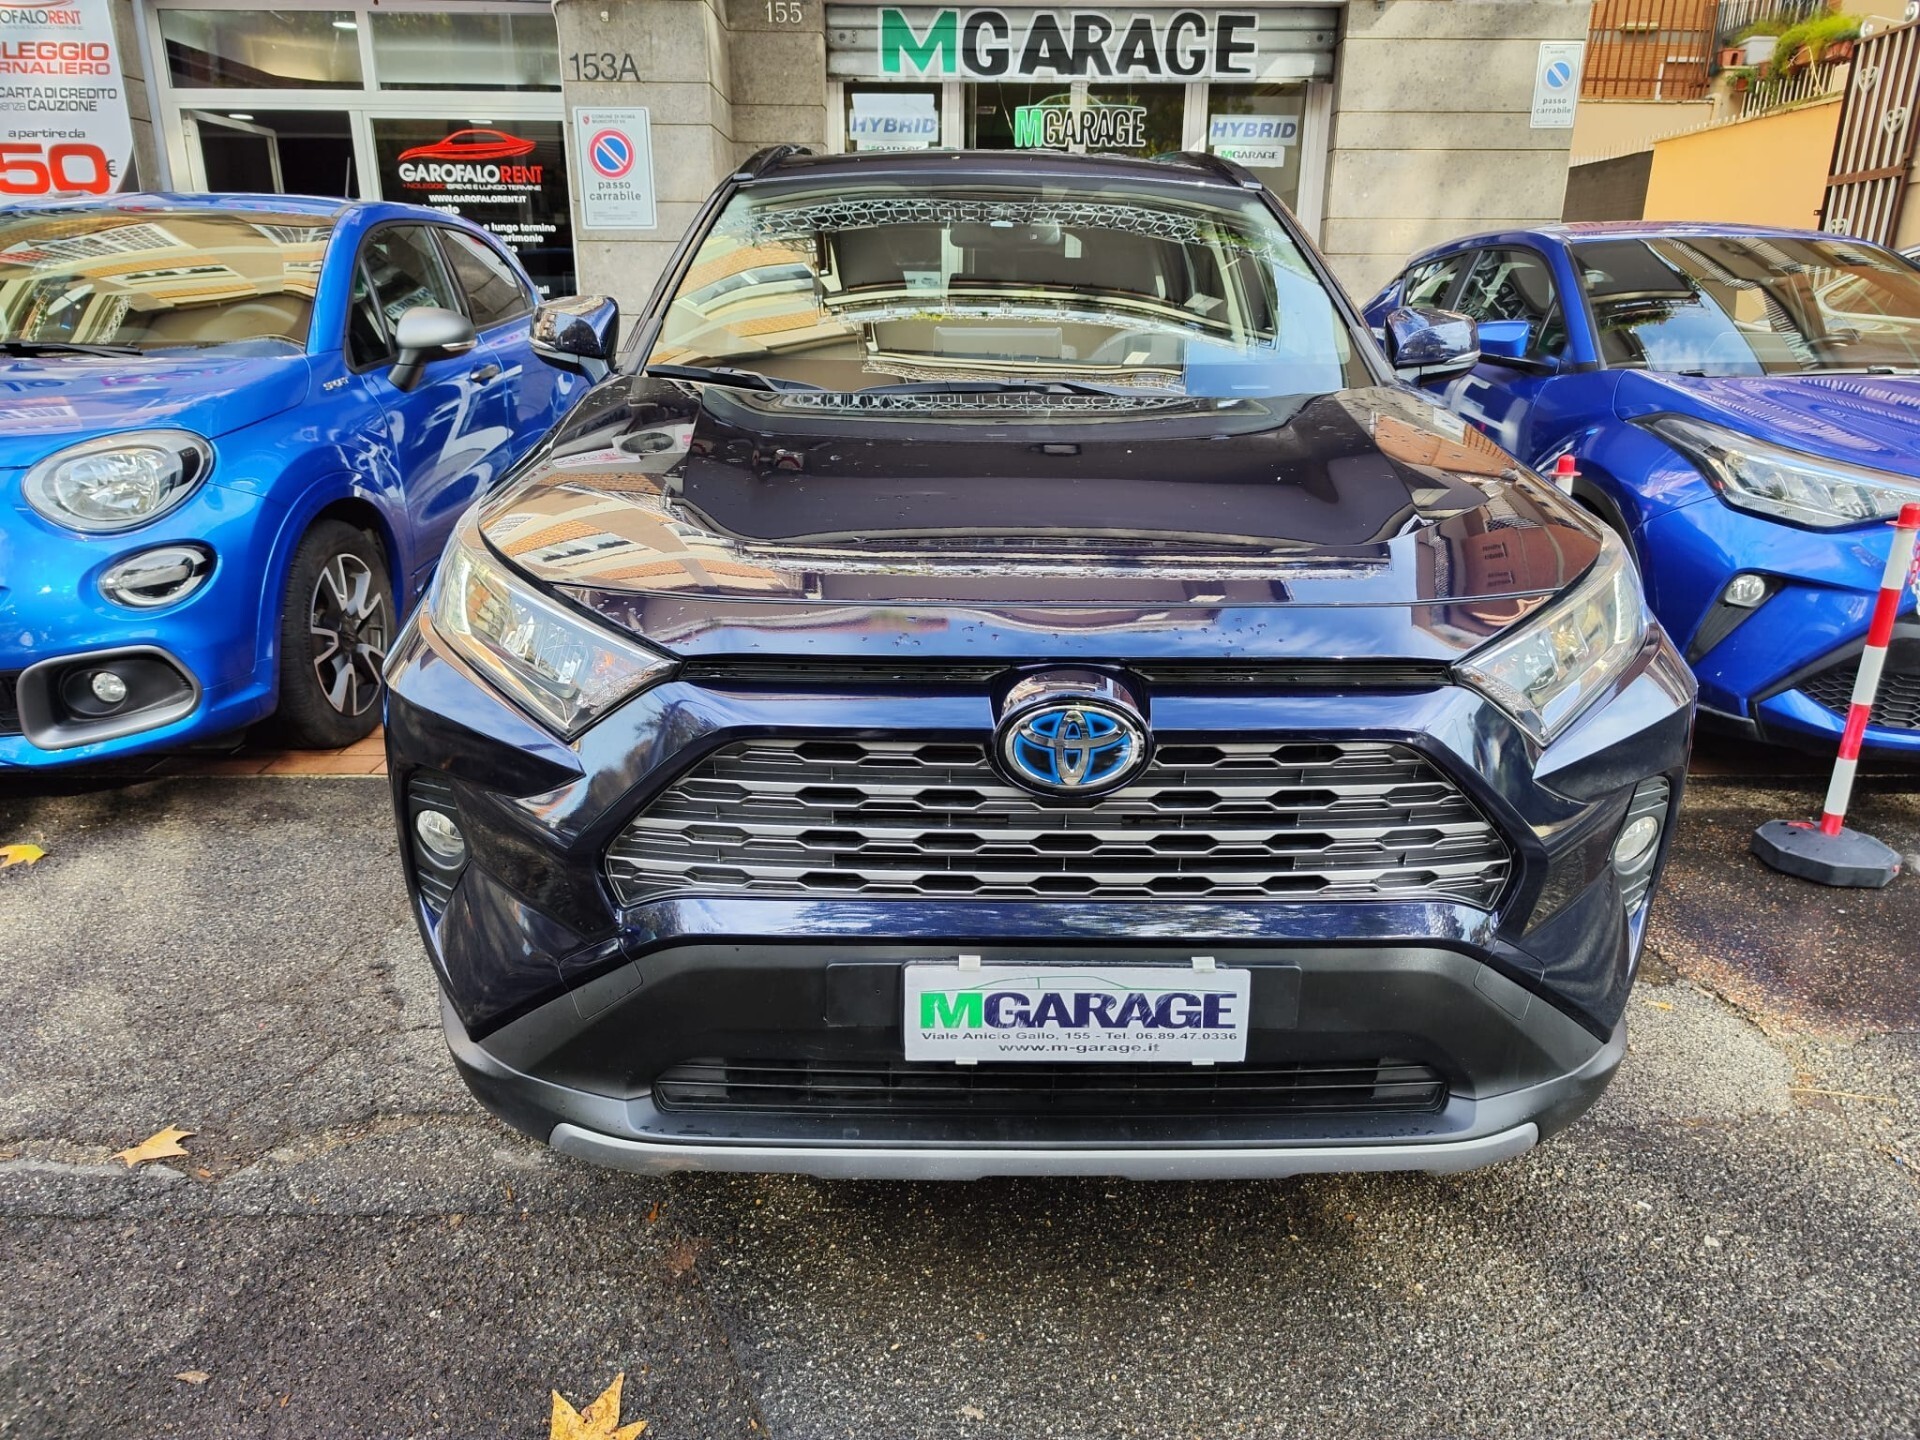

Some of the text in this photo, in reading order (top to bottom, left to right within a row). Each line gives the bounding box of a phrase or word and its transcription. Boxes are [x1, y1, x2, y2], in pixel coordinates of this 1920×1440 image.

[765, 2, 803, 23] 155
[882, 9, 1257, 76] MGARAGE
[0, 41, 109, 60] LEGGIO
[569, 52, 641, 81] 153A
[59, 88, 117, 99] CREDITO
[0, 99, 98, 111] enza CAUZIONE
[1542, 97, 1567, 105] passo
[1535, 106, 1571, 114] carrabile
[851, 115, 937, 134] HYBRID
[1014, 108, 1147, 148] MGARAGE
[1211, 121, 1297, 138] HYBRID
[8, 128, 86, 140] a partire da
[598, 182, 631, 191] passo
[428, 195, 527, 203] WWW.GAROFALORENT.IT
[589, 191, 642, 201] carrabile
[490, 222, 519, 234] lungo
[520, 223, 557, 233] termine
[920, 992, 1237, 1029] MGARAGE
[921, 1032, 958, 1040] Viale
[1065, 1032, 1091, 1040] 155
[1106, 1032, 1131, 1040] Tel.
[1135, 1032, 1238, 1041] 06.89.47.0336
[998, 1043, 1160, 1054] www.m-garage.it
